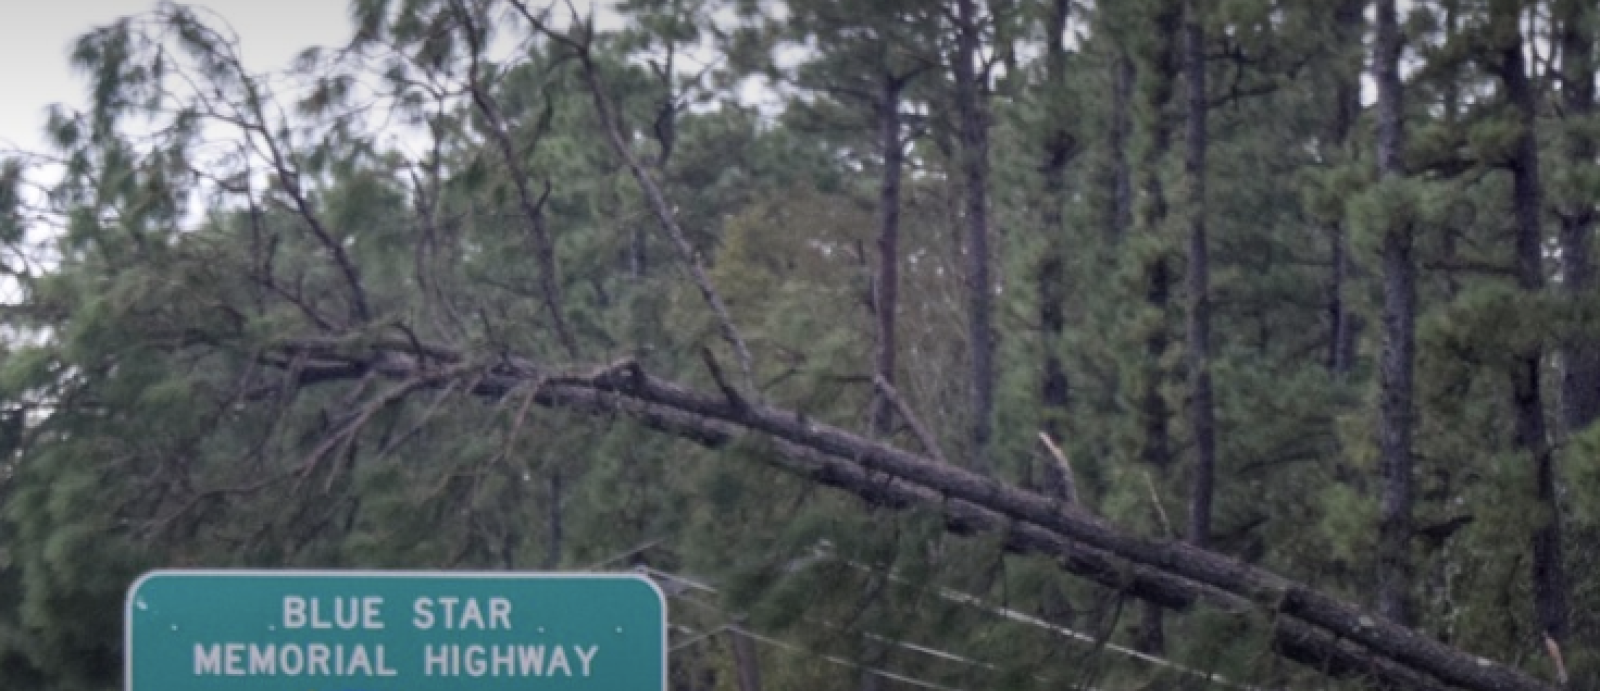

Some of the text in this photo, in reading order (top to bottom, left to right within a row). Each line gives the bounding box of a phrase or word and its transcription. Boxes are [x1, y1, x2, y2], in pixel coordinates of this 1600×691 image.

[283, 596, 512, 630] BLUE STAR
[194, 643, 598, 677] MEMORIAL HIGHWAY
